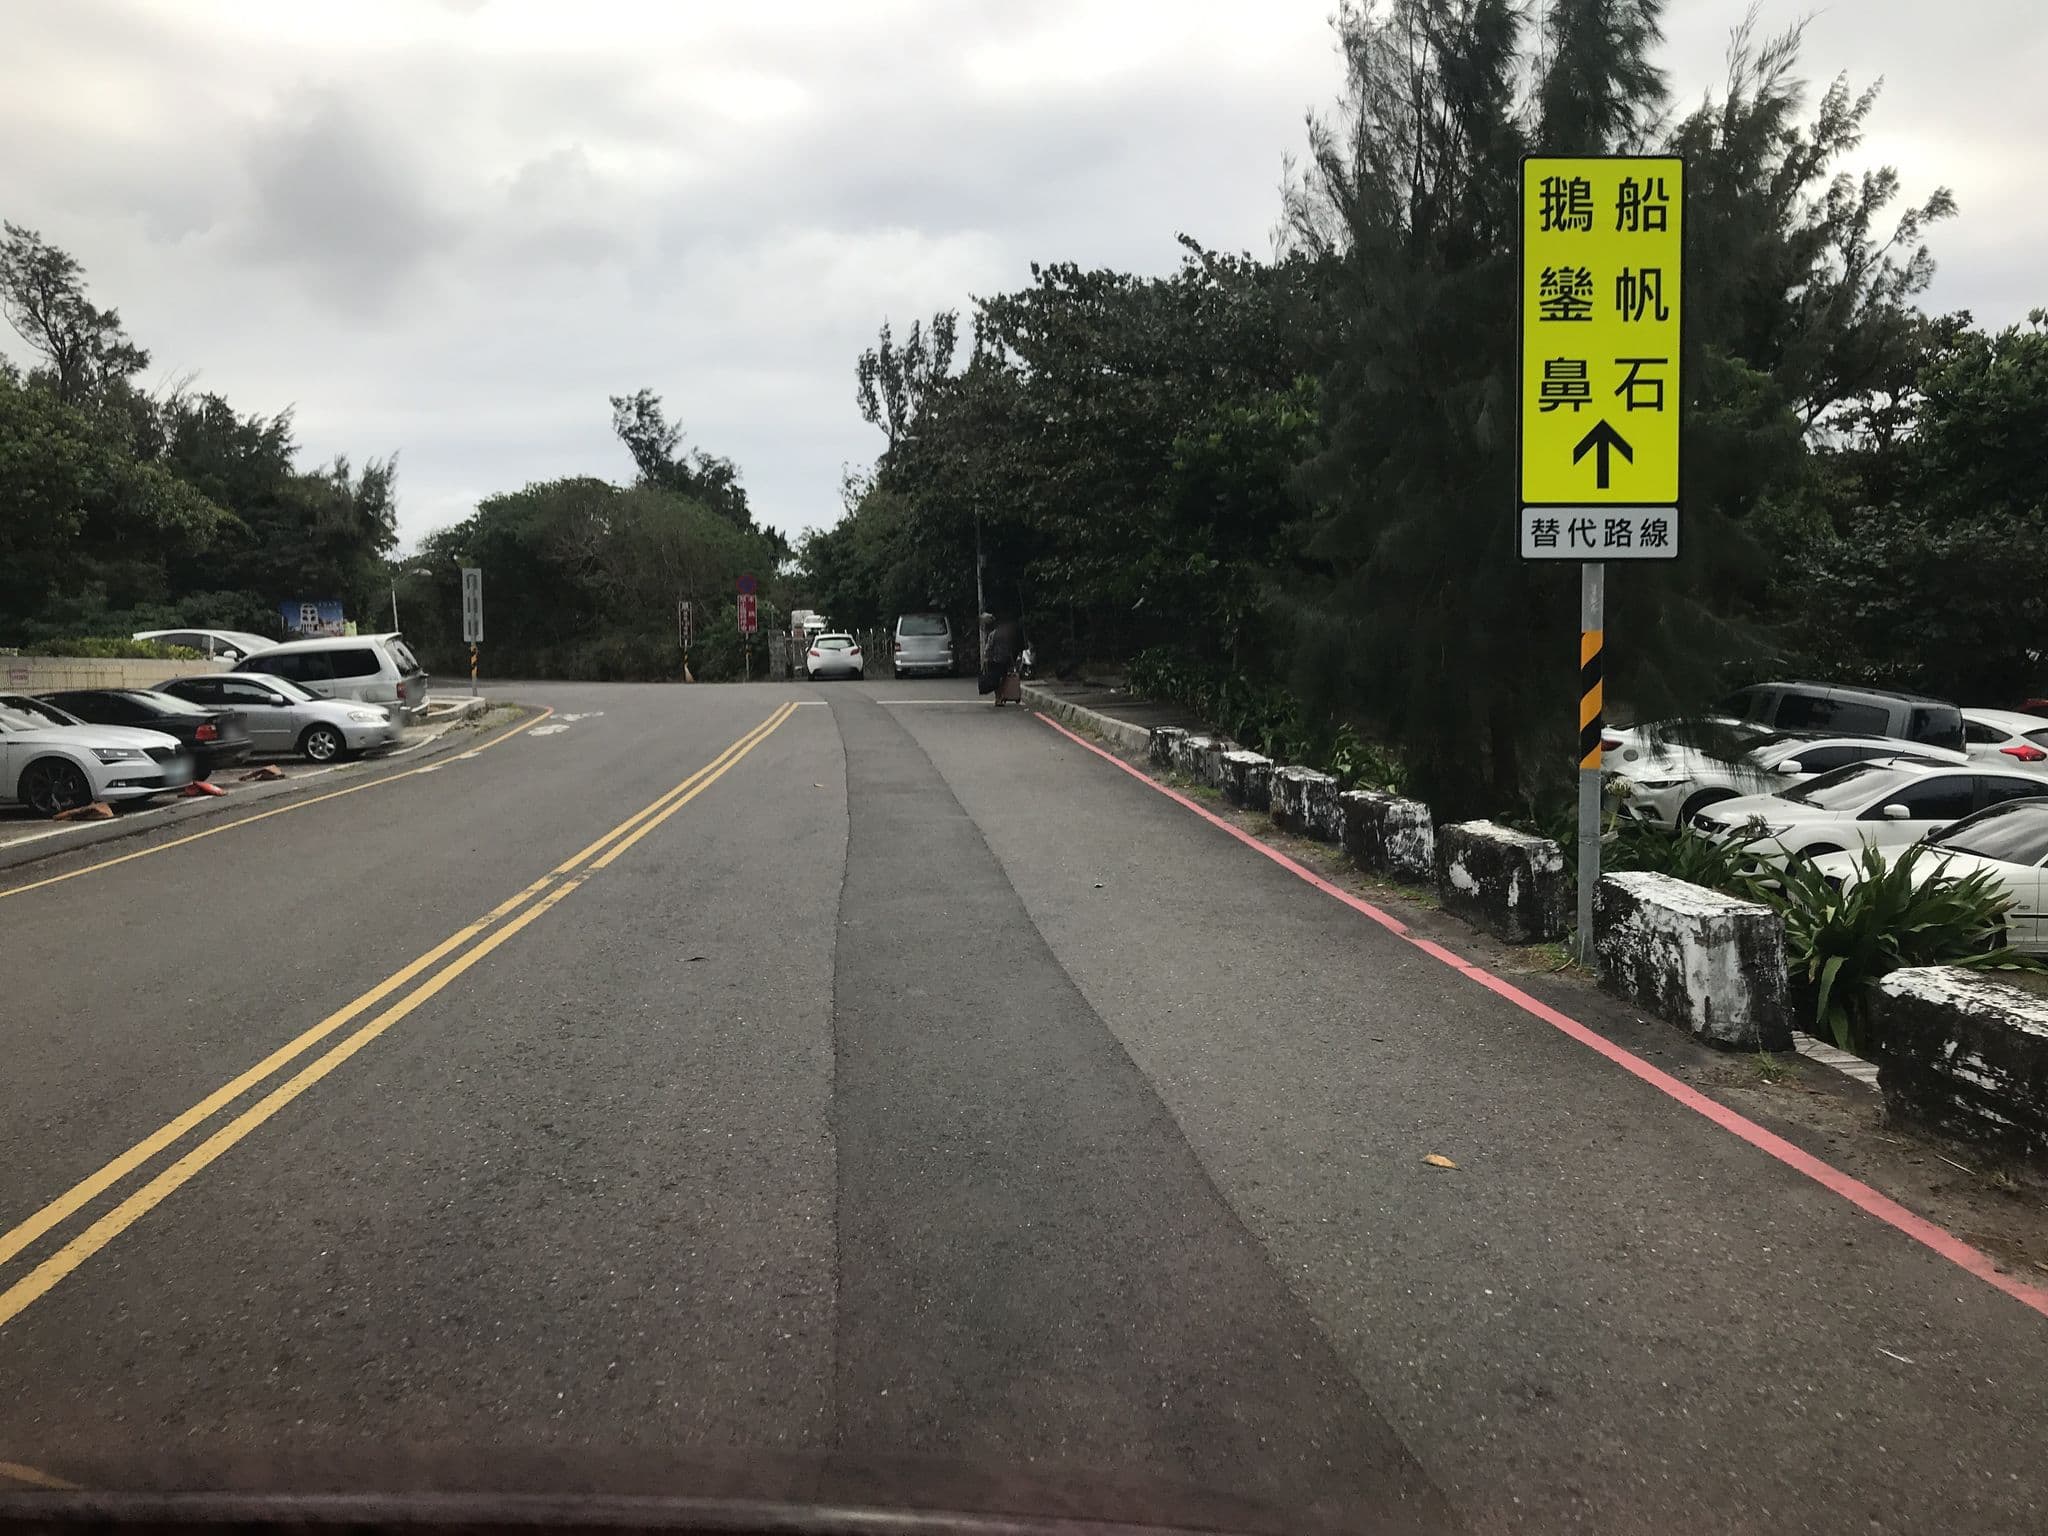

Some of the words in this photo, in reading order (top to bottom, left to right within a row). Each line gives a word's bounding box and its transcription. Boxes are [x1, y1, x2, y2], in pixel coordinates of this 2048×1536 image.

[1538, 175, 1594, 413] 鵝鑾鼻
[1613, 176, 1670, 413] 船帆石
[1530, 517, 1669, 549] 替代路線
